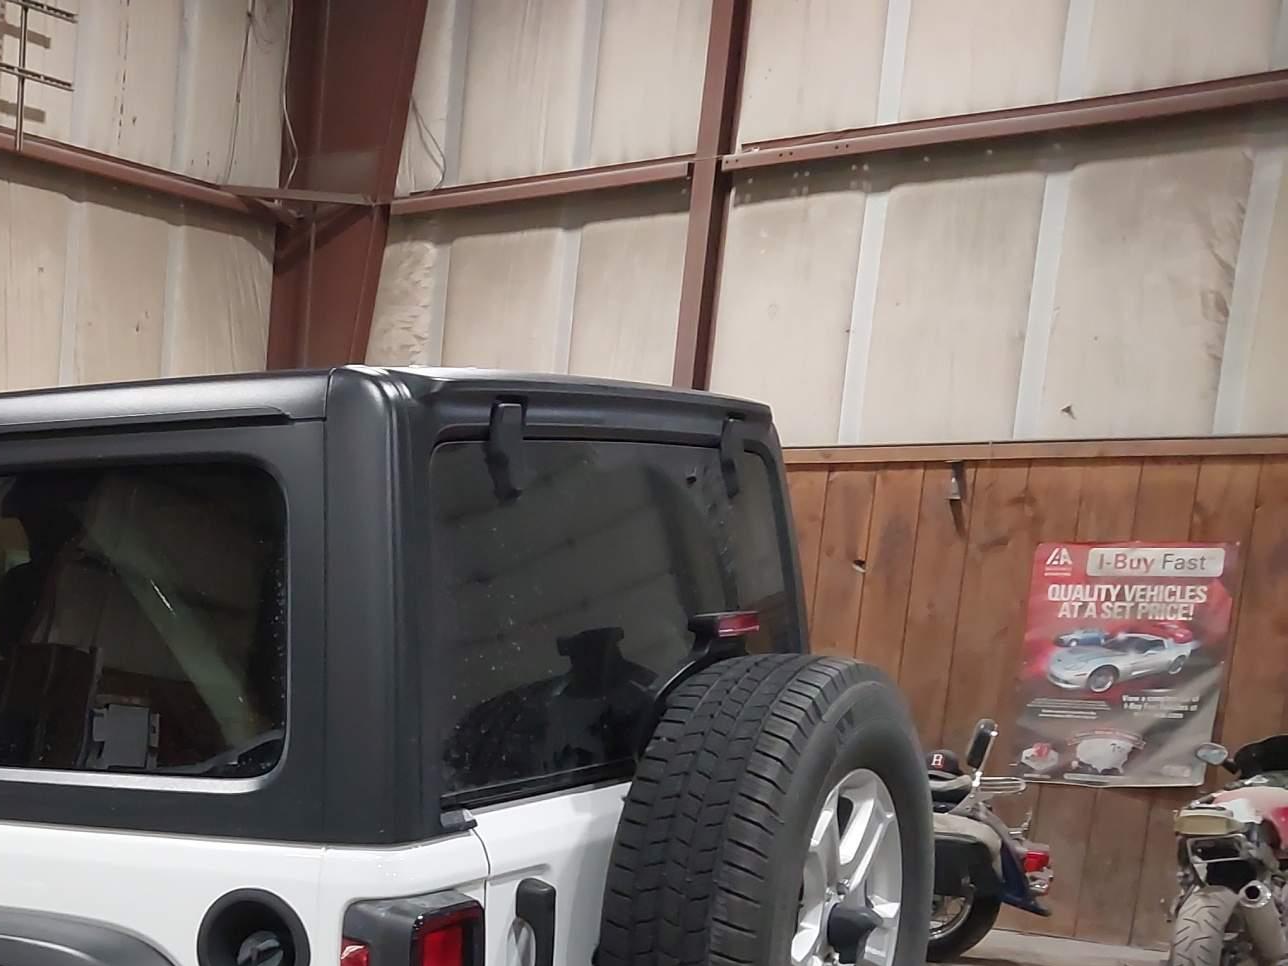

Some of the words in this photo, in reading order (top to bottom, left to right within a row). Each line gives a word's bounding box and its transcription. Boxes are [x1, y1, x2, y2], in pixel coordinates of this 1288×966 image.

[1098, 553, 1155, 573] I-Buy
[1162, 552, 1207, 570] Fast
[1047, 584, 1120, 601] QUALITY
[1124, 585, 1208, 603] VEHICLES
[1057, 602, 1083, 618] AT
[1084, 602, 1097, 618] A
[1101, 602, 1135, 619] SET
[1136, 603, 1195, 621] PRICE!
